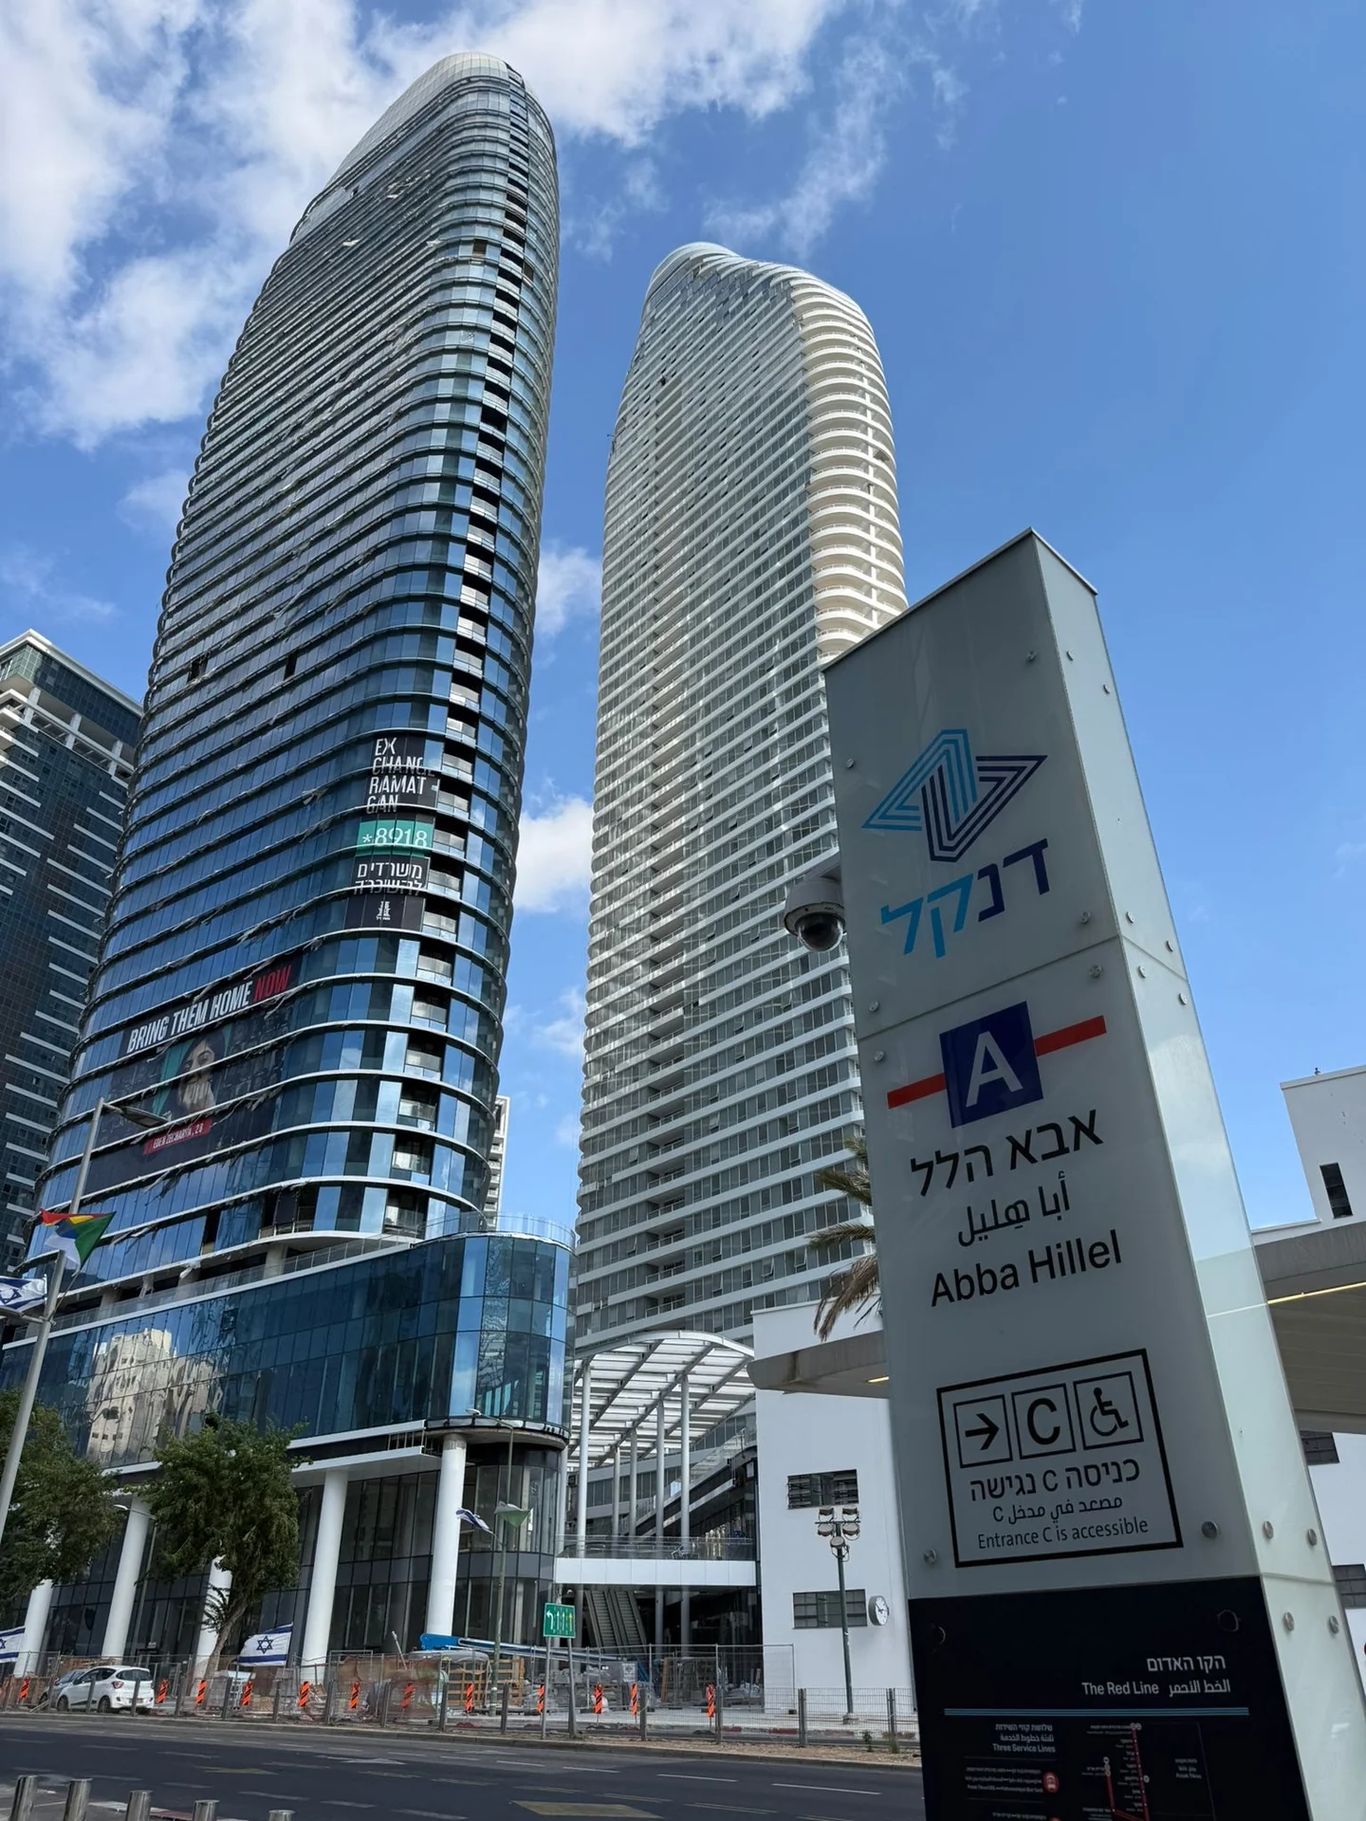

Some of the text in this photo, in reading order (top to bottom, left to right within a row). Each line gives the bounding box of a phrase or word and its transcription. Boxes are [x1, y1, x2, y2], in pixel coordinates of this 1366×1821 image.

[375, 737, 397, 756] EX
[369, 775, 427, 795] RAMAT
[366, 794, 399, 814] GAN
[357, 861, 423, 880] משרדים
[881, 838, 1050, 959] דנקל
[126, 964, 292, 1053] BRING THEM HOME NOW
[966, 1030, 1023, 1108] A
[910, 1109, 1104, 1197] אבא הלל
[1038, 1170, 1070, 1221] أبا
[931, 1229, 1122, 1307] Abba Hillel
[1027, 1398, 1061, 1445] C
[970, 1458, 1141, 1501] כניסה C נגישה
[993, 1496, 1123, 1525] مصعد في مدخل C
[978, 1516, 1149, 1549] Entrance C is accessible
[1146, 1655, 1227, 1674] הקו האדום
[1081, 1681, 1160, 1696] The Red Line
[1204, 1678, 1231, 1694] الخط
[1012, 1743, 1037, 1753] Service
[1037, 1744, 1056, 1753] Lines
